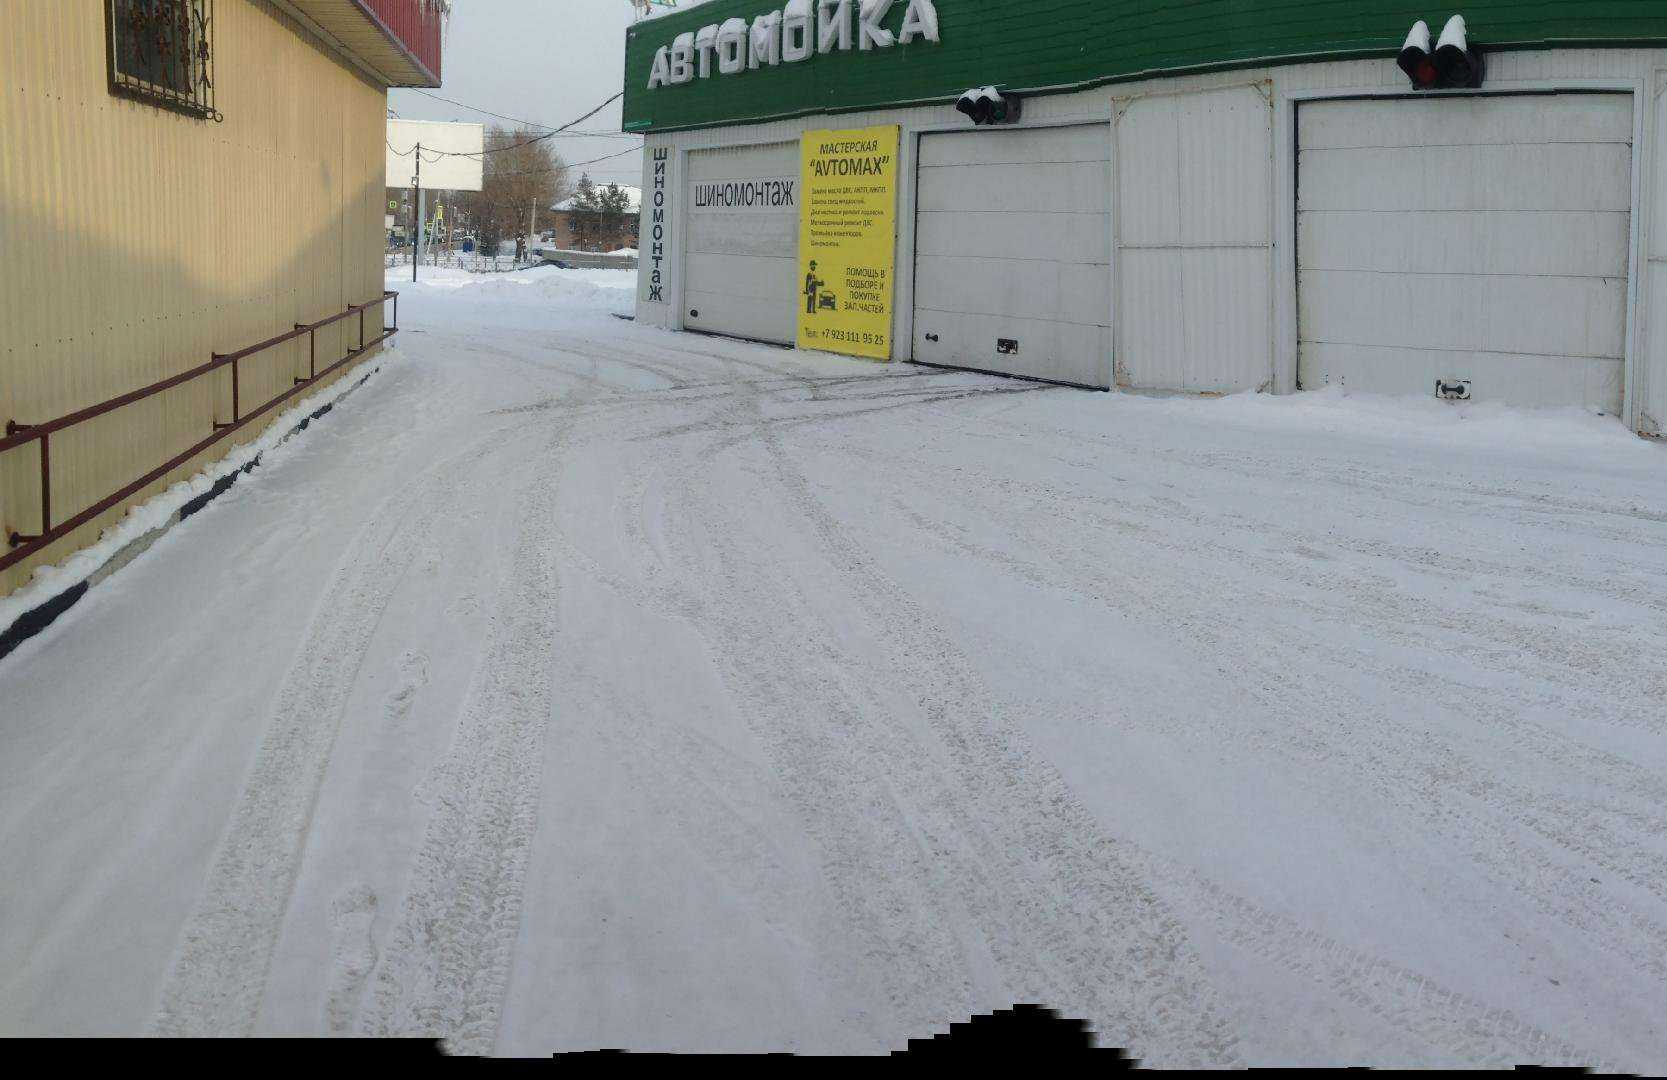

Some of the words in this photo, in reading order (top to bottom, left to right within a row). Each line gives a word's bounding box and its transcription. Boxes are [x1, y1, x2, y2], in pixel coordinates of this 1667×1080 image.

[819, 140, 878, 155] МАСТЕРСКАЯ
[846, 267, 879, 278] ПОМОЩЬ
[880, 269, 886, 279] В
[846, 279, 878, 290] ПОДБОРЕ
[879, 281, 884, 291] И
[849, 291, 881, 302] ПОКУПКЕ
[831, 330, 845, 341] 923
[846, 331, 860, 343] 111
